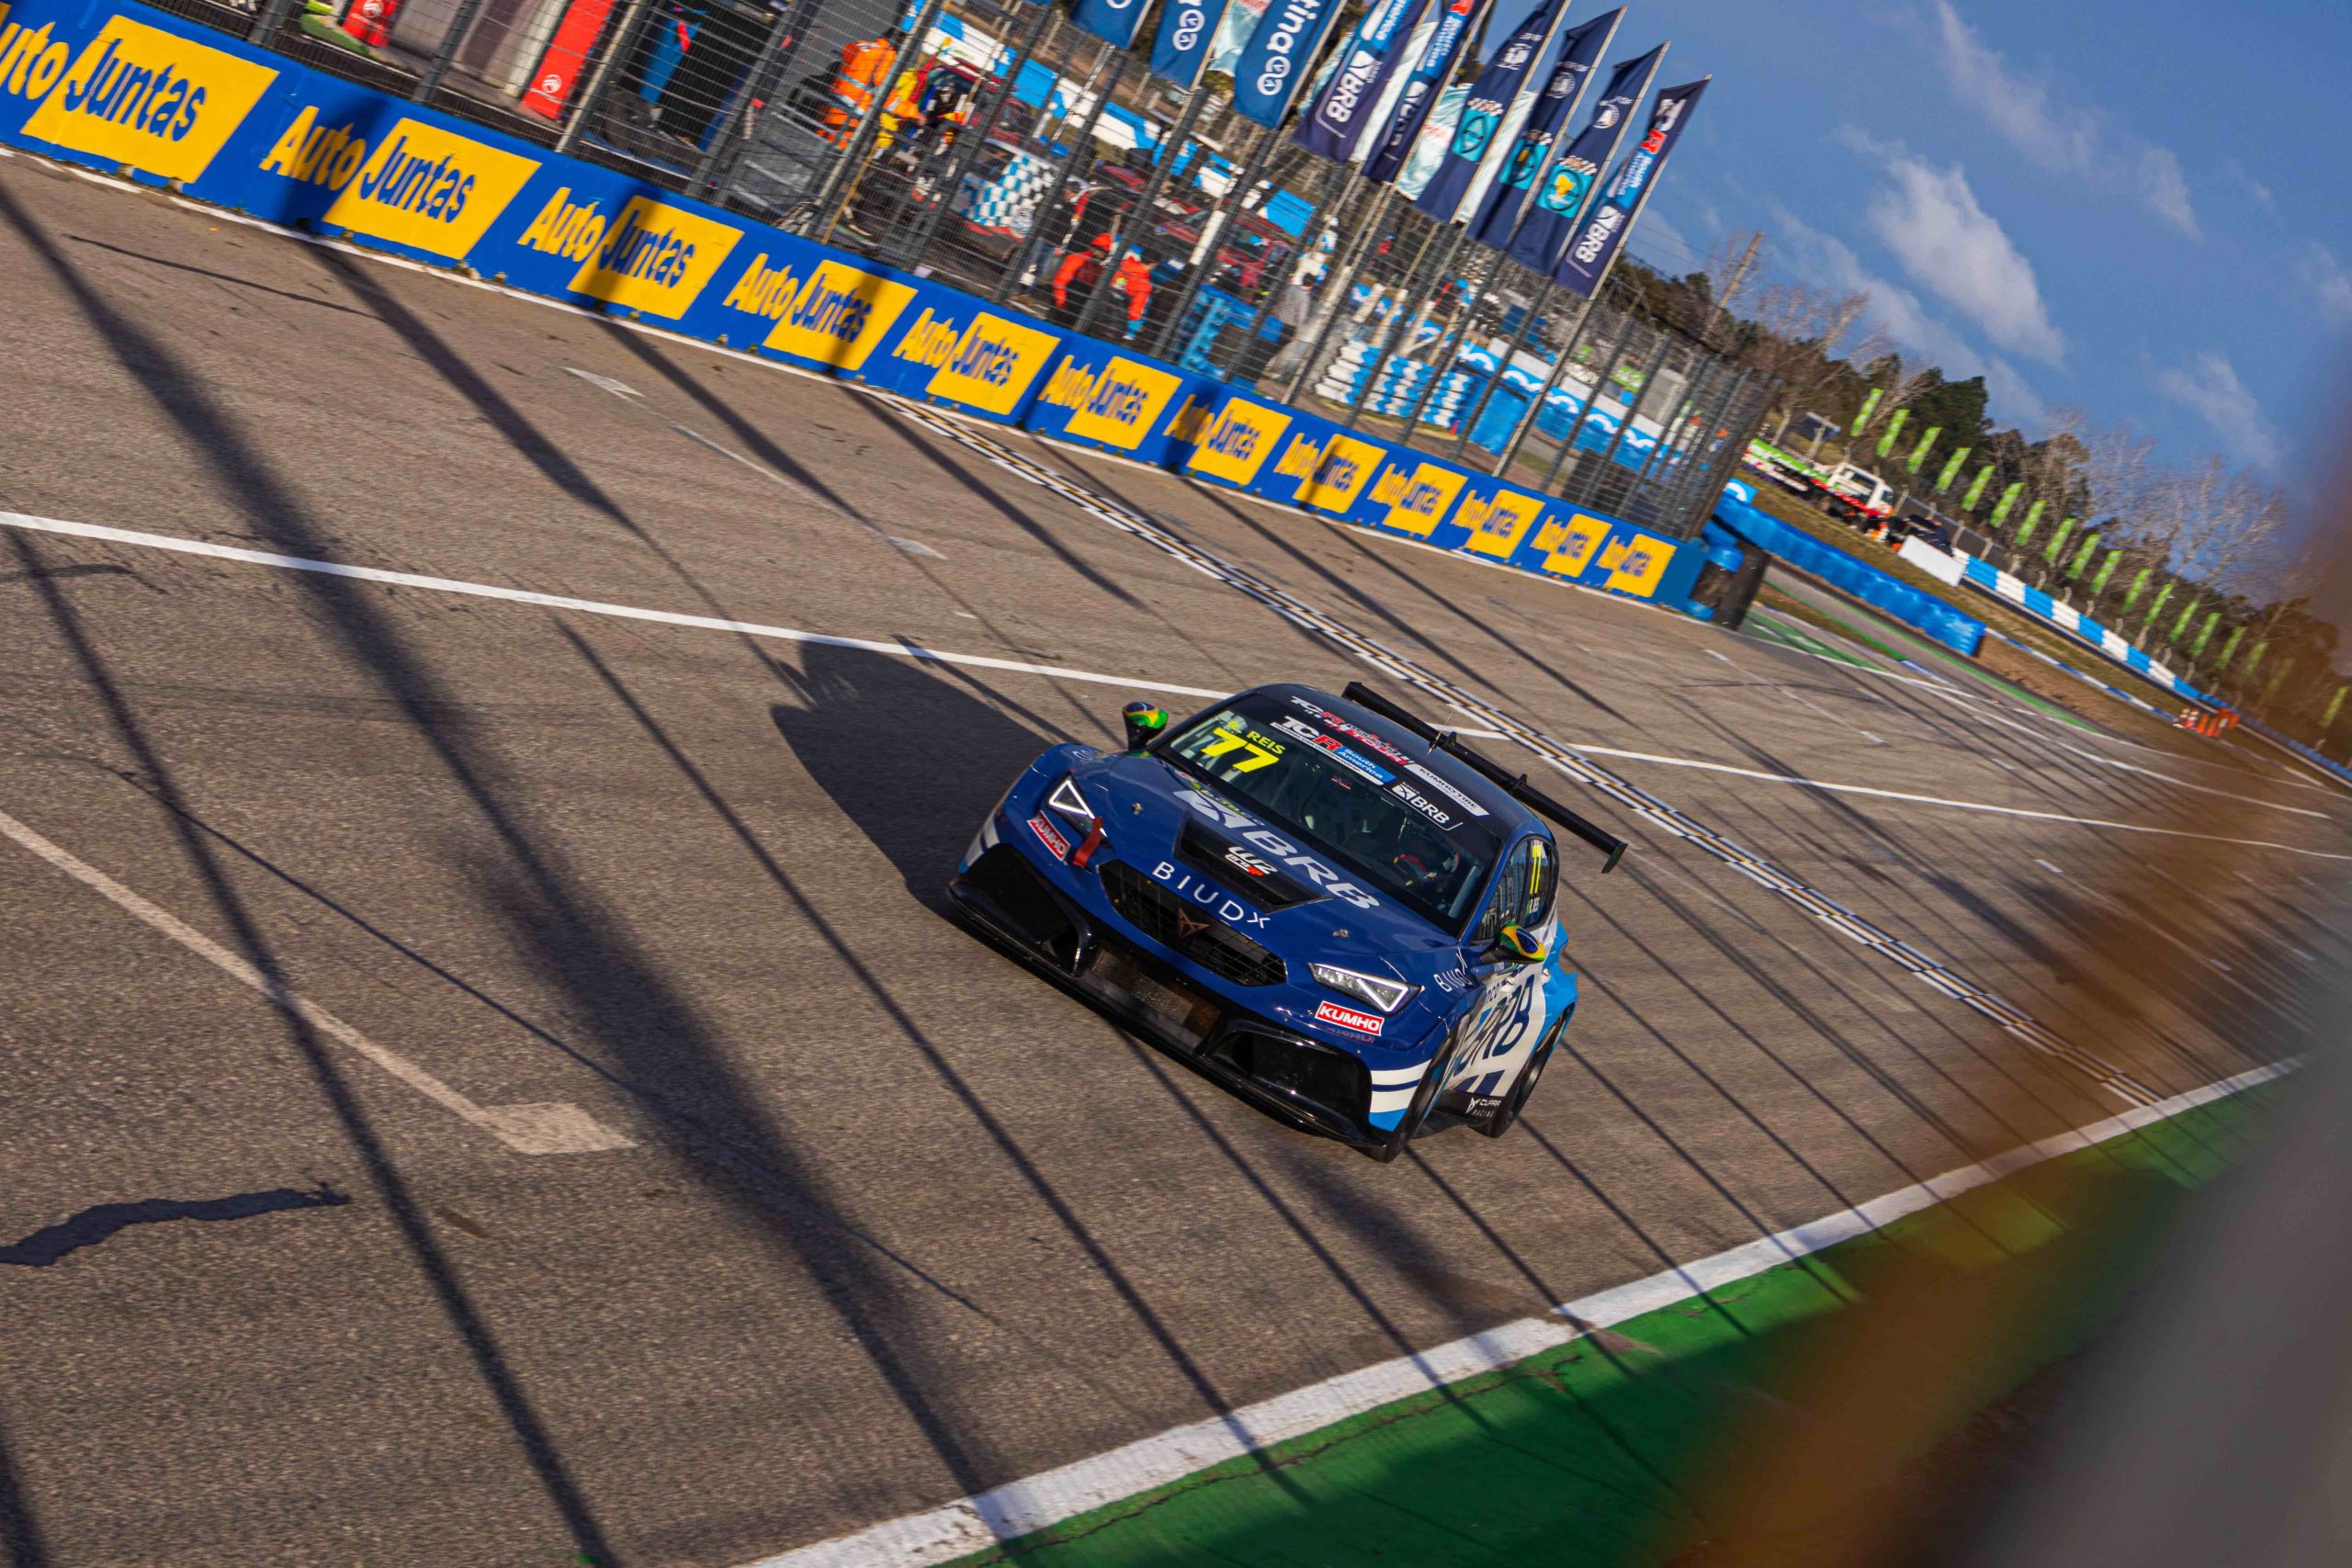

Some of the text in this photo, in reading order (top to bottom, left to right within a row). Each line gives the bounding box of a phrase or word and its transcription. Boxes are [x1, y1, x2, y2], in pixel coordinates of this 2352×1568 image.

[0, 21, 208, 142] uto Juntas
[1326, 73, 1363, 123] BRB
[260, 106, 476, 224] Auto Juntas
[517, 187, 695, 289] Auto Juntas
[1576, 223, 1608, 264] BRB
[723, 254, 872, 344] Auto Juntas
[891, 308, 959, 368] Auto
[1200, 727, 1280, 773] 77
[1246, 730, 1286, 754] REIS
[1283, 716, 1376, 771] TCR South
[1337, 750, 1385, 780] America
[1409, 794, 1451, 826] BRB
[1419, 769, 1456, 795] KUMHO
[1456, 793, 1478, 809] TIRE
[1242, 830, 1380, 909] BRB
[1318, 1006, 1381, 1032] KUMHO
